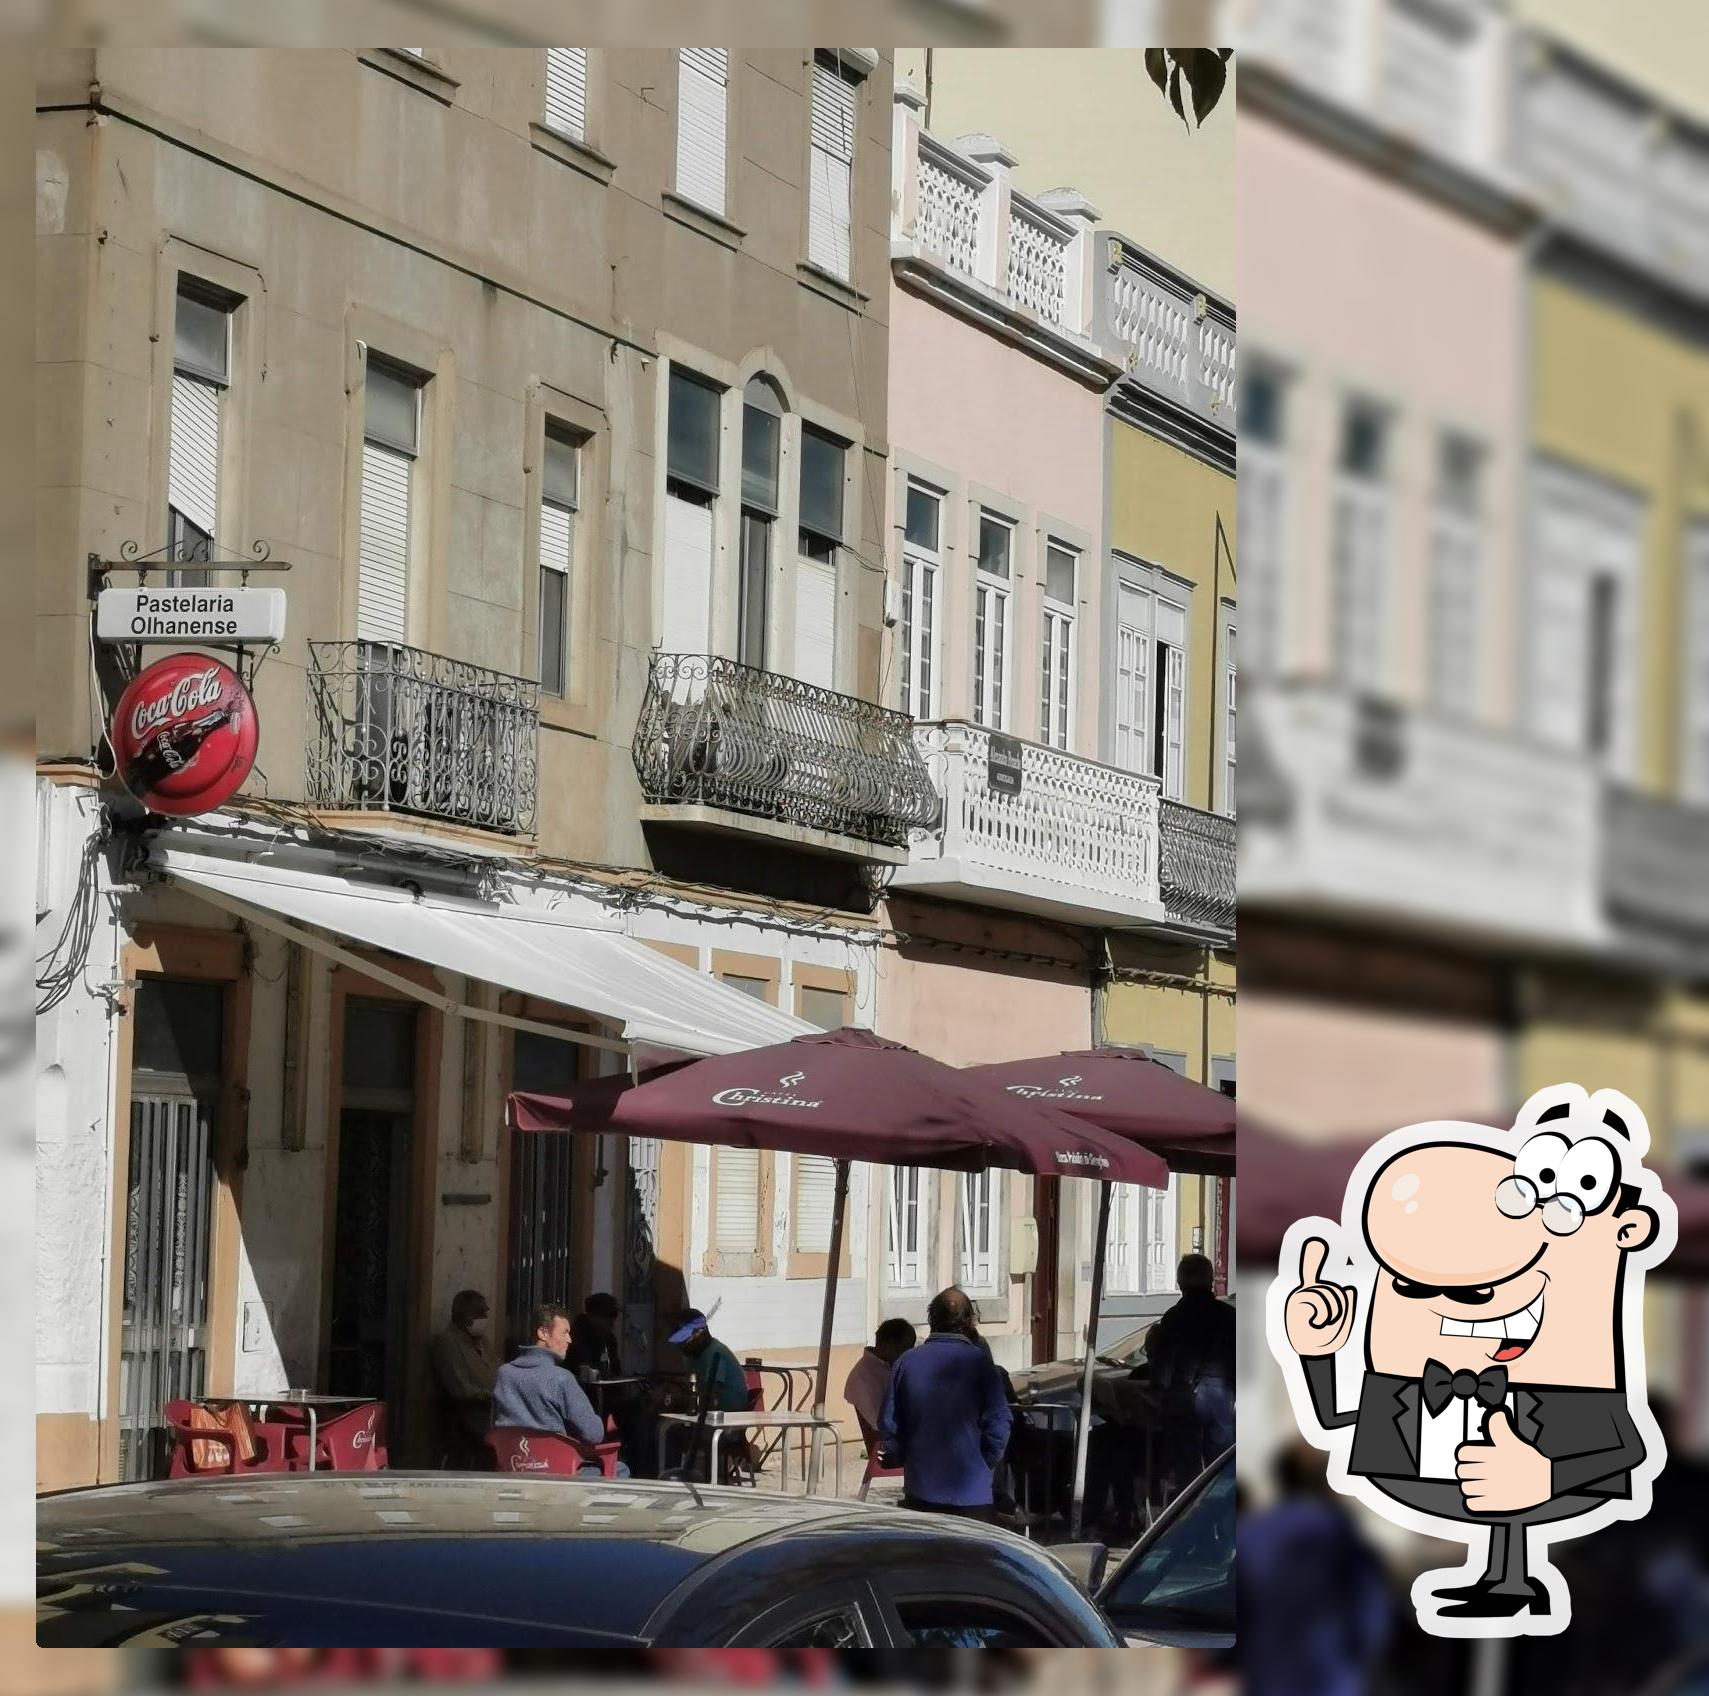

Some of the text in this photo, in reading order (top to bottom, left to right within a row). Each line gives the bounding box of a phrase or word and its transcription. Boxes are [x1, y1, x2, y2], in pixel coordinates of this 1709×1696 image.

[136, 594, 234, 613] Pastelaria
[131, 616, 238, 635] Olhanense
[712, 1087, 823, 1108] Christina
